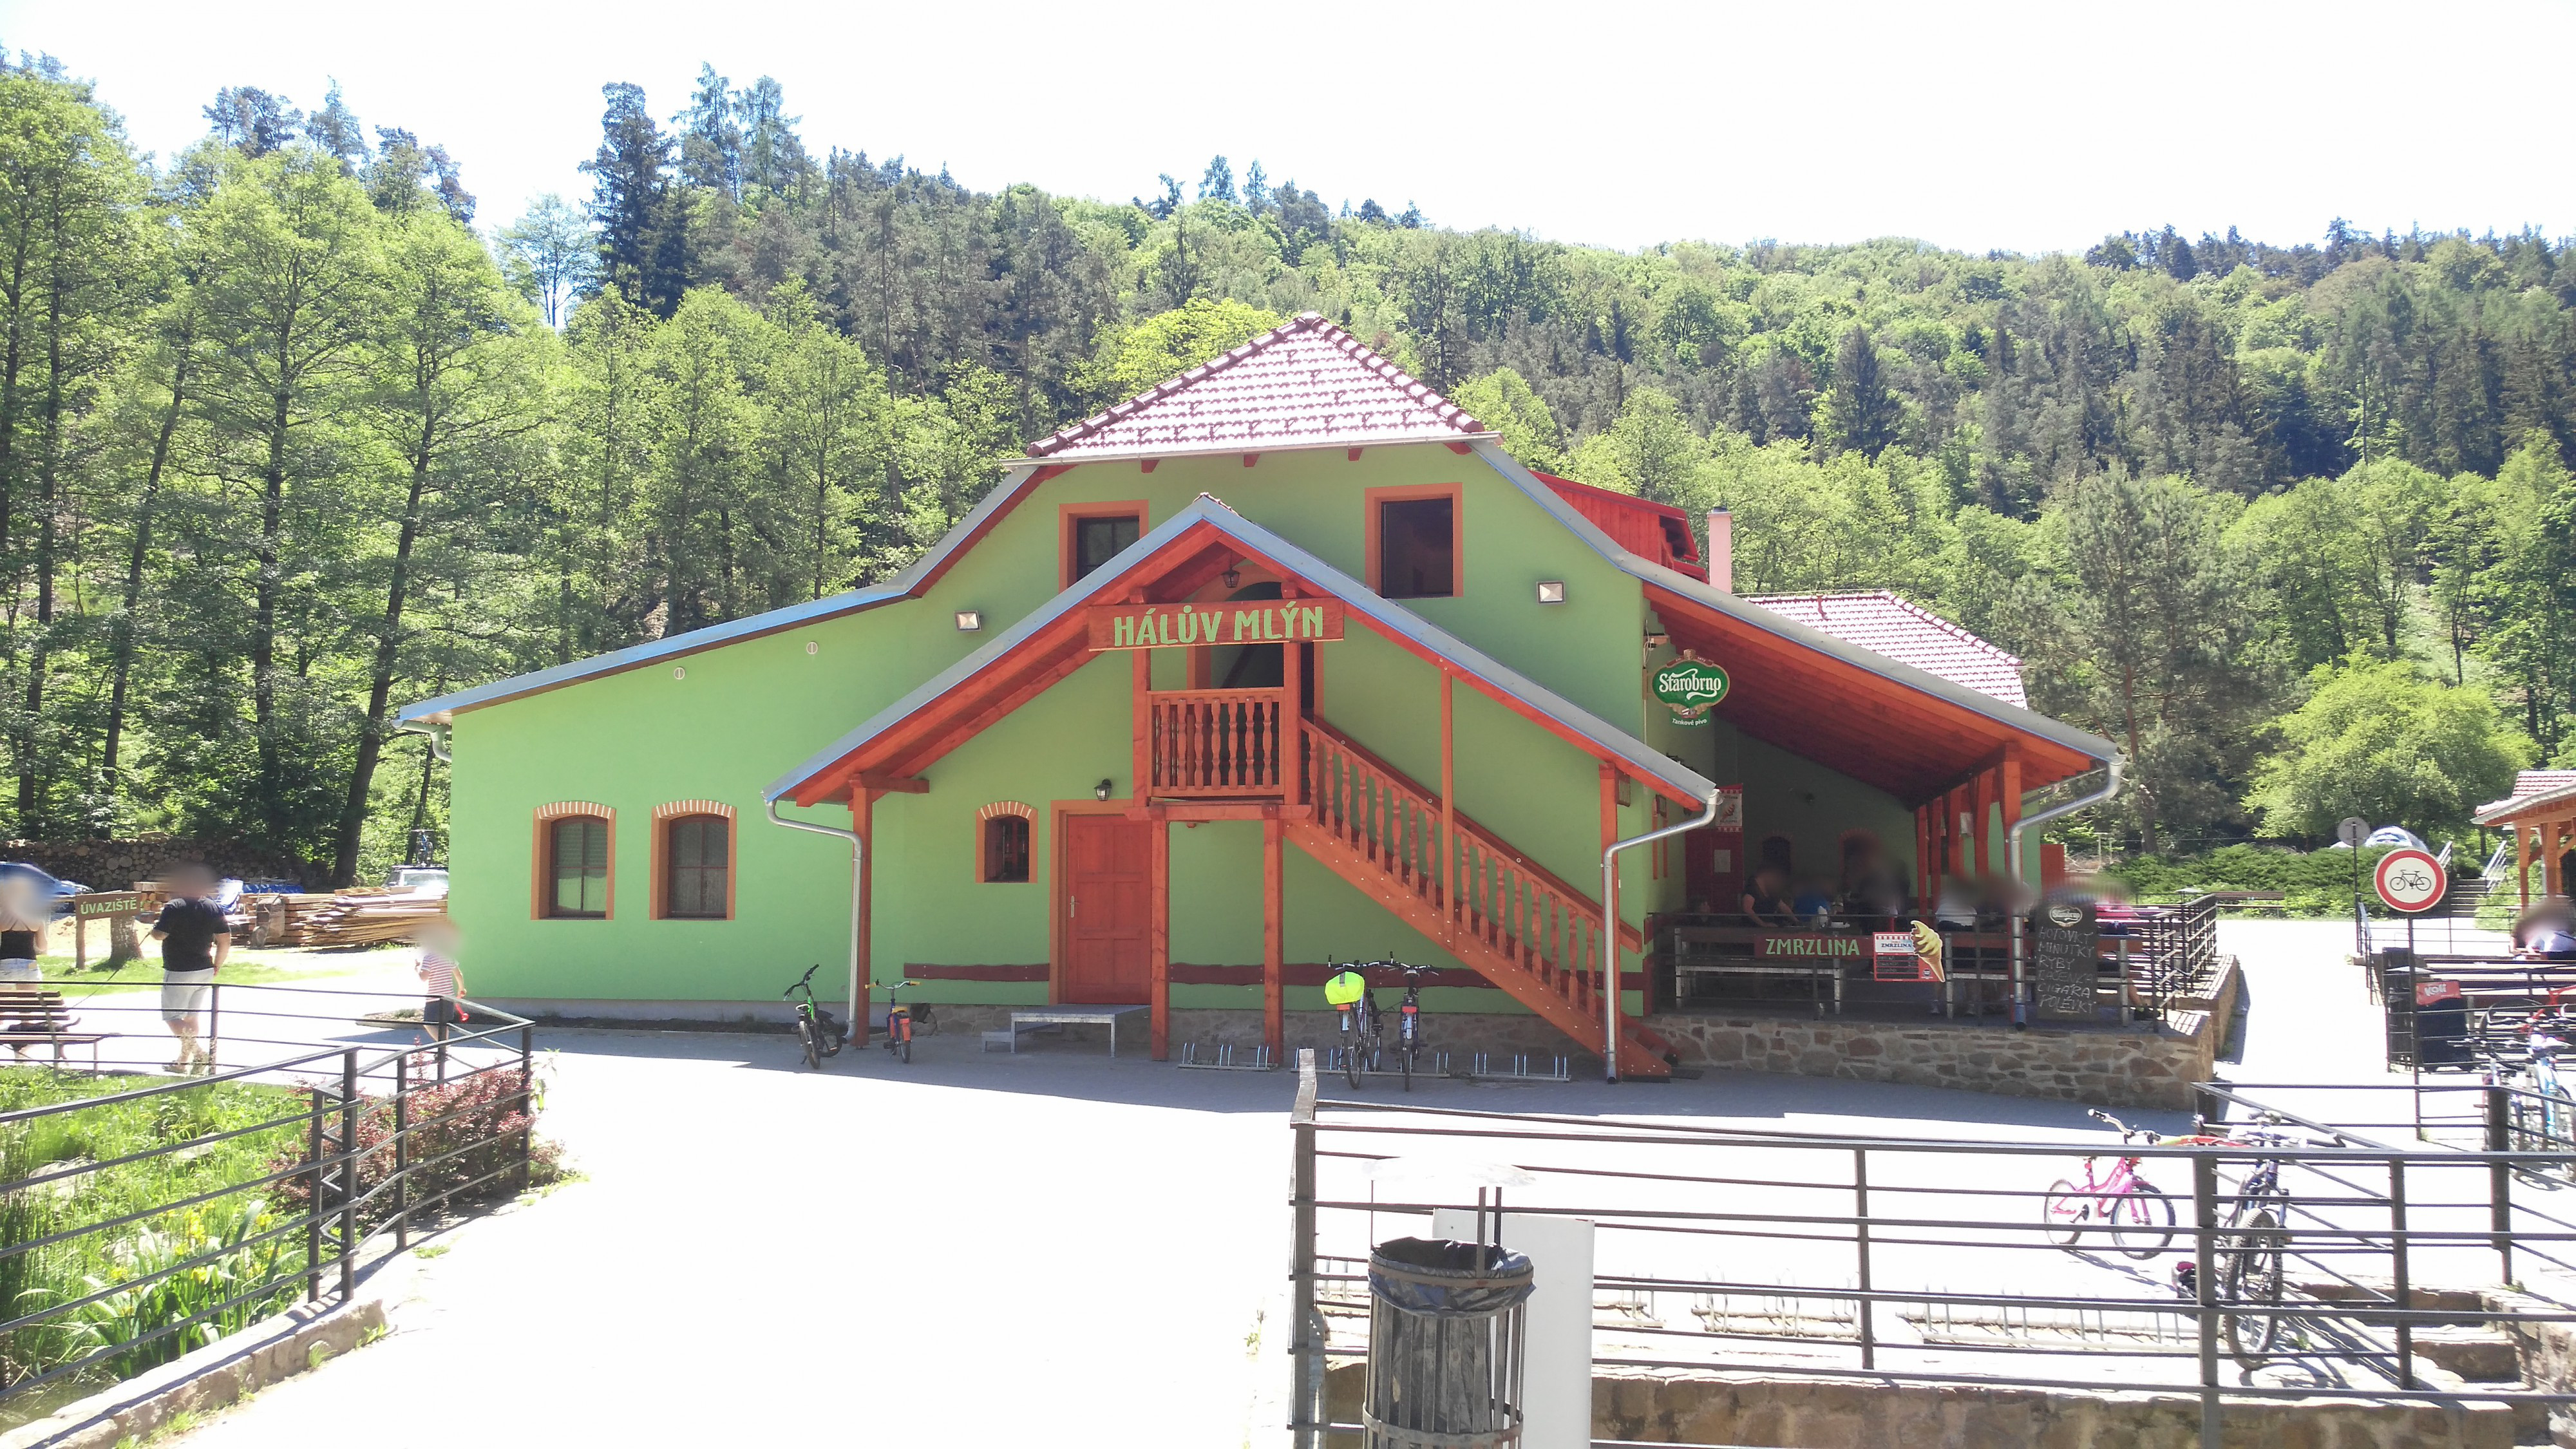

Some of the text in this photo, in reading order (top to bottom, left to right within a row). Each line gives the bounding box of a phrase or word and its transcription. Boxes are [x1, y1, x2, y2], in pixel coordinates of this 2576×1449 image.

[1114, 601, 1323, 646] HÁLŮV MLÝN
[1659, 668, 1721, 700] Starobrno
[80, 896, 137, 914] ÚVAZIŠTĚ
[1765, 938, 1861, 956] ZMRZLINA
[2040, 954, 2075, 970] RYBY
